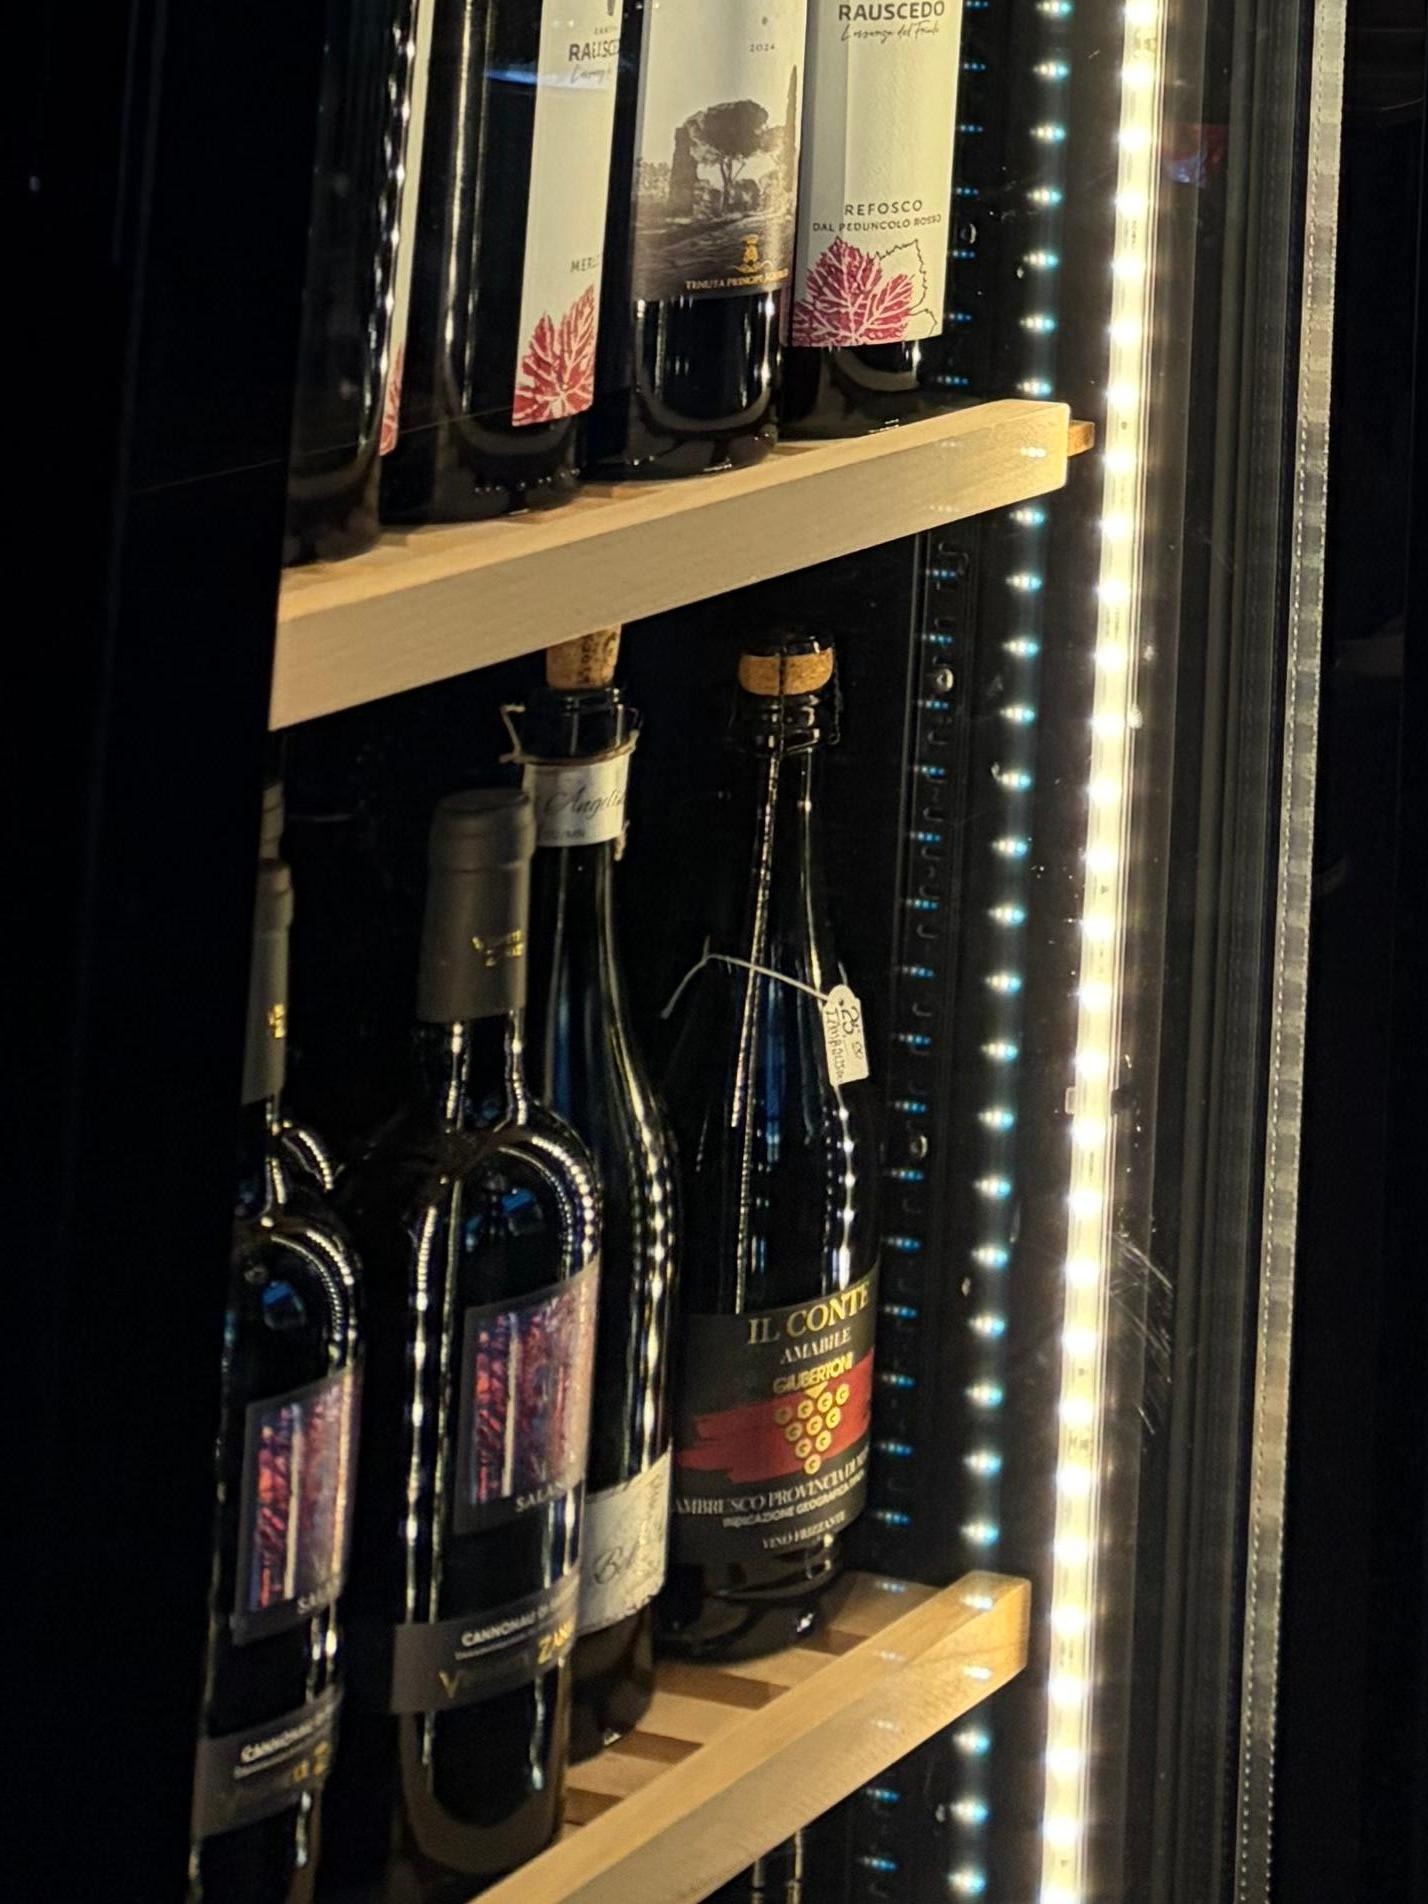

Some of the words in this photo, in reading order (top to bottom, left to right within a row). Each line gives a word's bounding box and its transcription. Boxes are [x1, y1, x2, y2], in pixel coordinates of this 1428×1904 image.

[838, 0, 945, 22] RAUSCEDO
[844, 199, 924, 216] REFOSCO
[812, 222, 836, 233] DAL
[838, 218, 911, 232] PEDUNCOLO
[748, 1316, 780, 1345] IL
[786, 1280, 870, 1338] CONTE
[780, 1326, 852, 1364] AMABILE
[773, 1351, 855, 1394] GIUBERTONI
